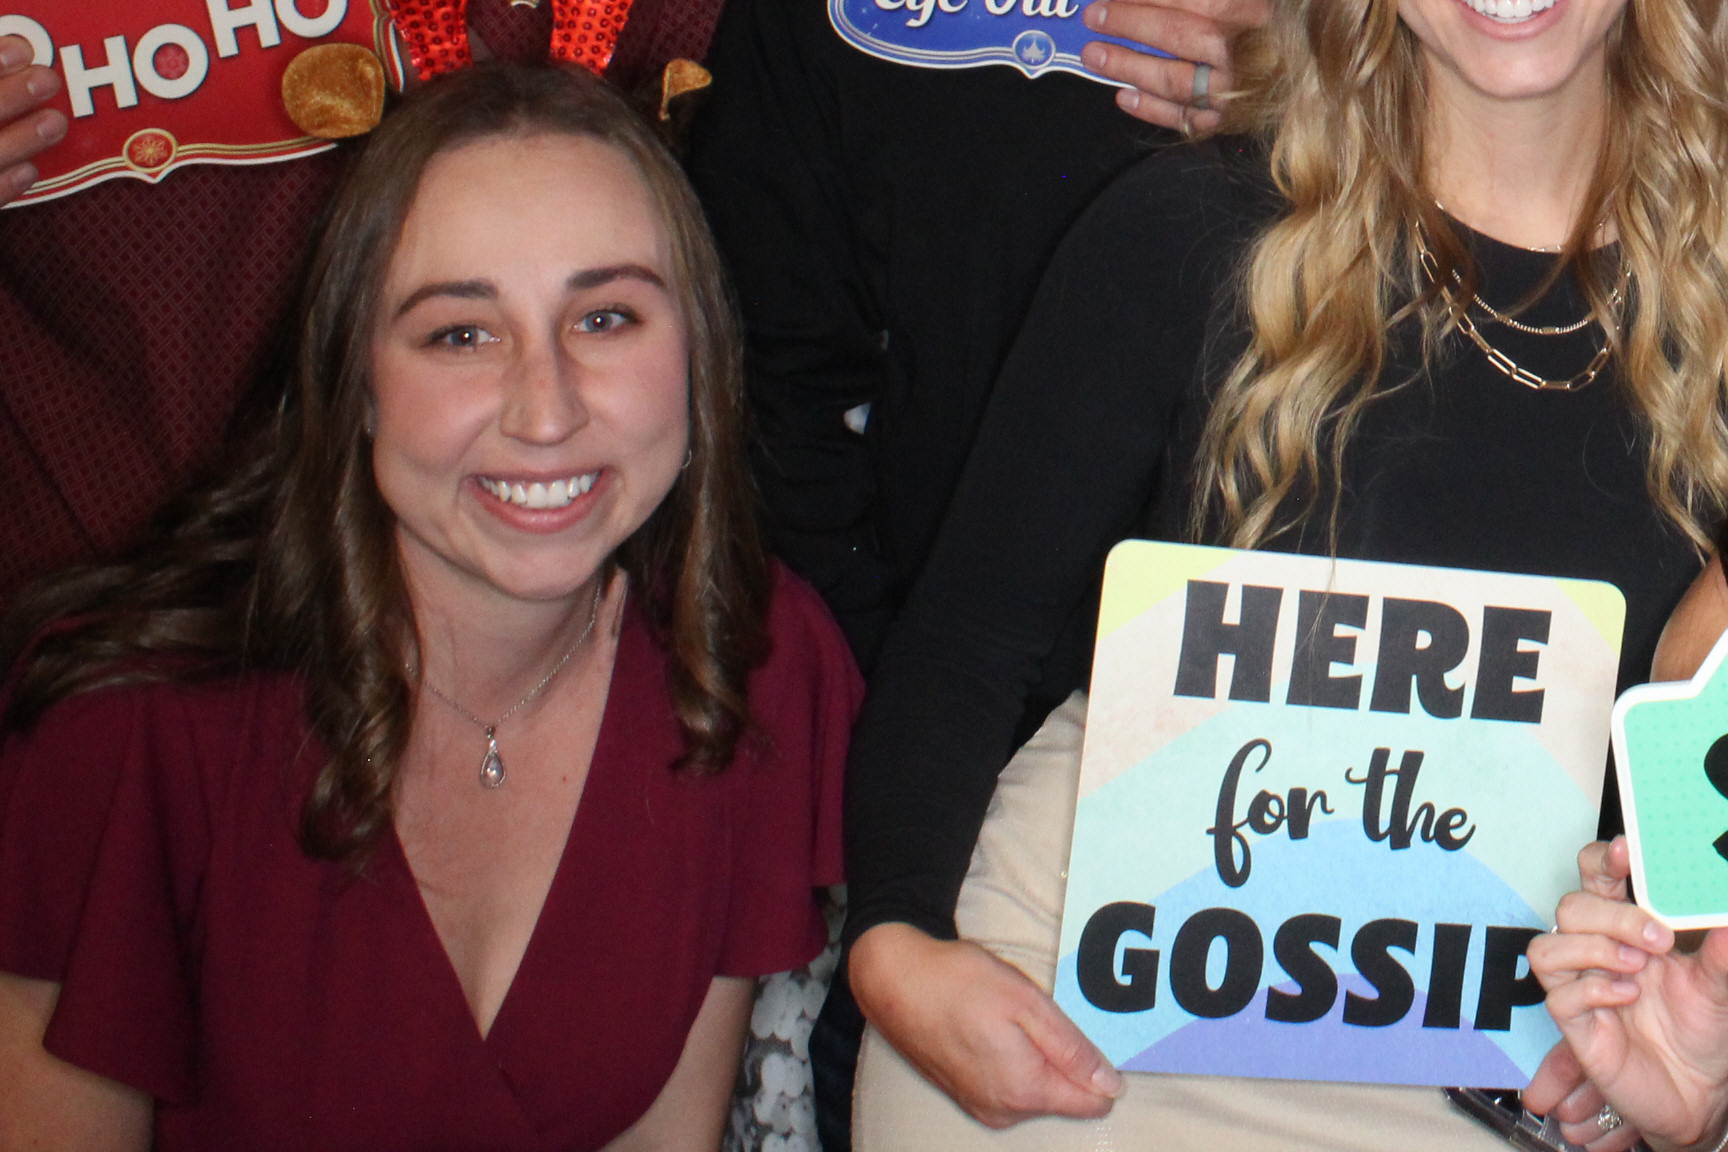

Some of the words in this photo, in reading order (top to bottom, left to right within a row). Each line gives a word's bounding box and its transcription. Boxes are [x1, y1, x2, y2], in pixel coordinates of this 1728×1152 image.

[1173, 578, 1553, 724] HERE
[1206, 738, 1334, 888] for
[1344, 747, 1477, 852] the
[1075, 900, 1548, 1032] GOSSIP
